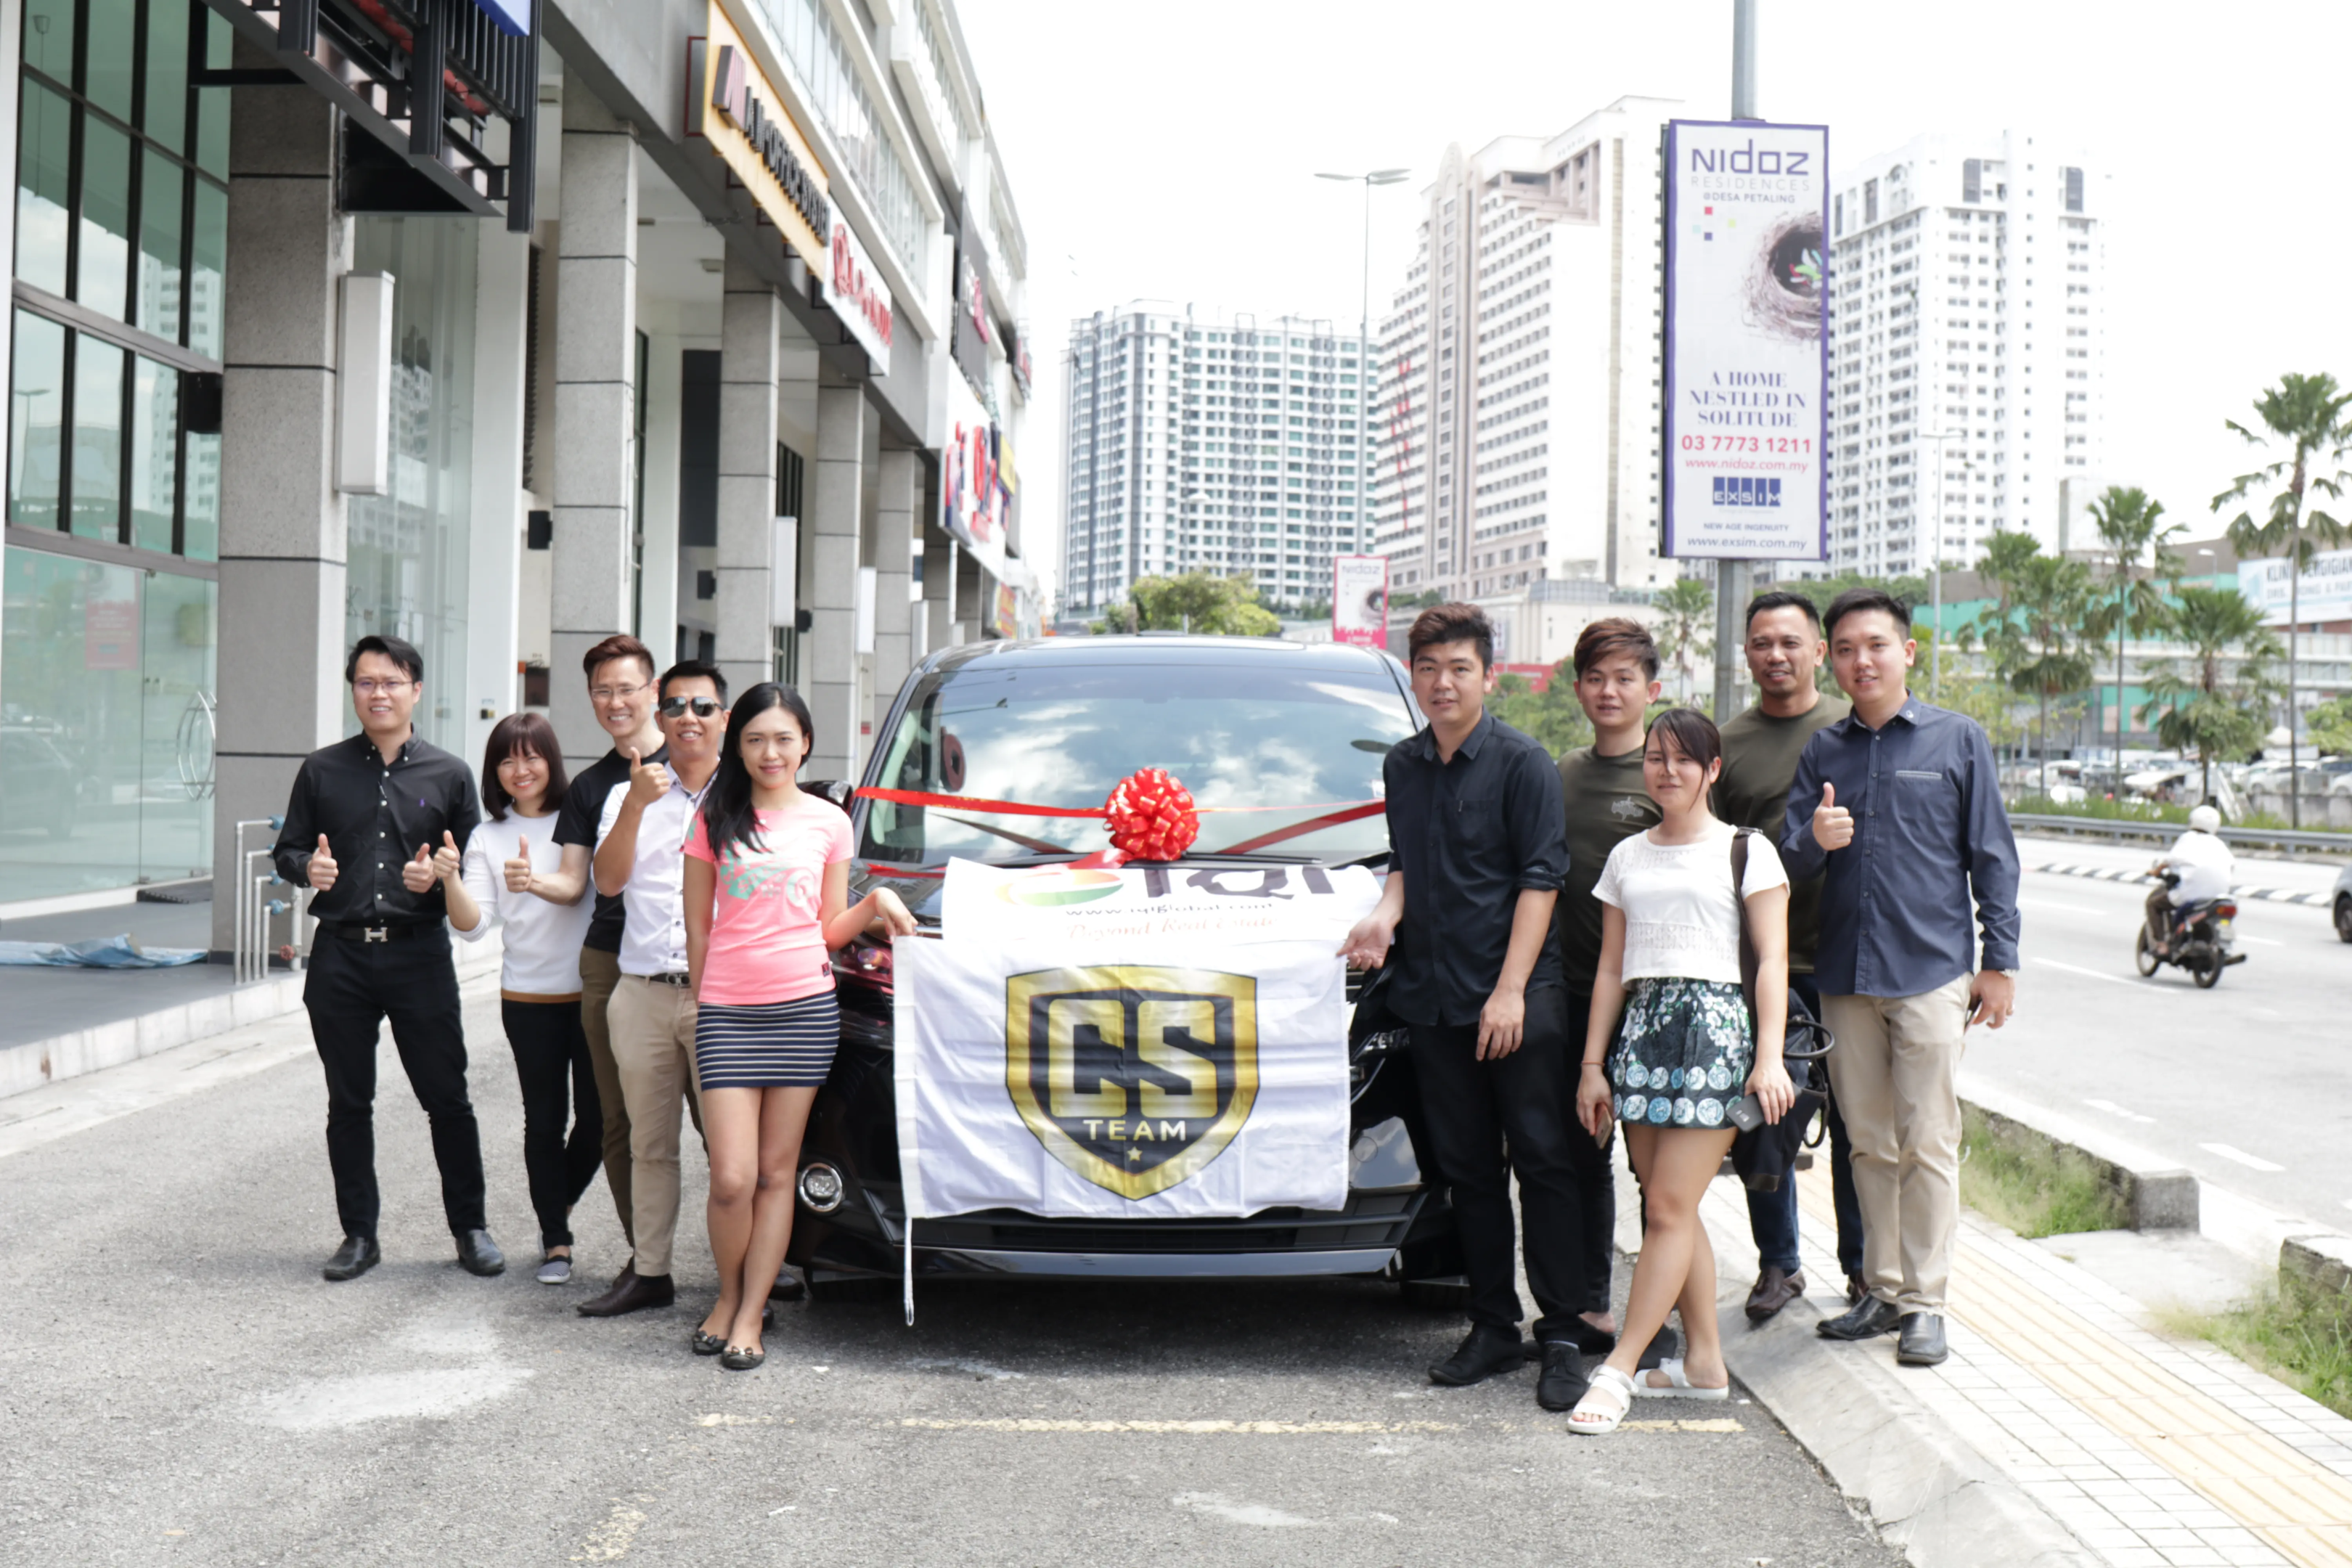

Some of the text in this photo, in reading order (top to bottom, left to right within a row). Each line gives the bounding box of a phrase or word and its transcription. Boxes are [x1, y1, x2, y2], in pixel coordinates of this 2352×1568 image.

[1691, 176, 1810, 192] RESIDENCES
[1744, 194, 1795, 203] PETALING
[1710, 371, 1787, 388] A HOME
[1689, 391, 1806, 408] NESTLED IN
[1697, 410, 1798, 428] SOLITUDE
[1681, 435, 1811, 453] 03 7773 1211
[1685, 457, 1808, 474] www.nidoz.com.my
[1687, 537, 1807, 552] www.exsim.com.my
[2266, 561, 2298, 583] KLINI
[1067, 920, 1151, 942] Beyond
[1161, 917, 1208, 934] Real
[1048, 997, 1219, 1118] CS
[1083, 1119, 1188, 1142] TEAM
